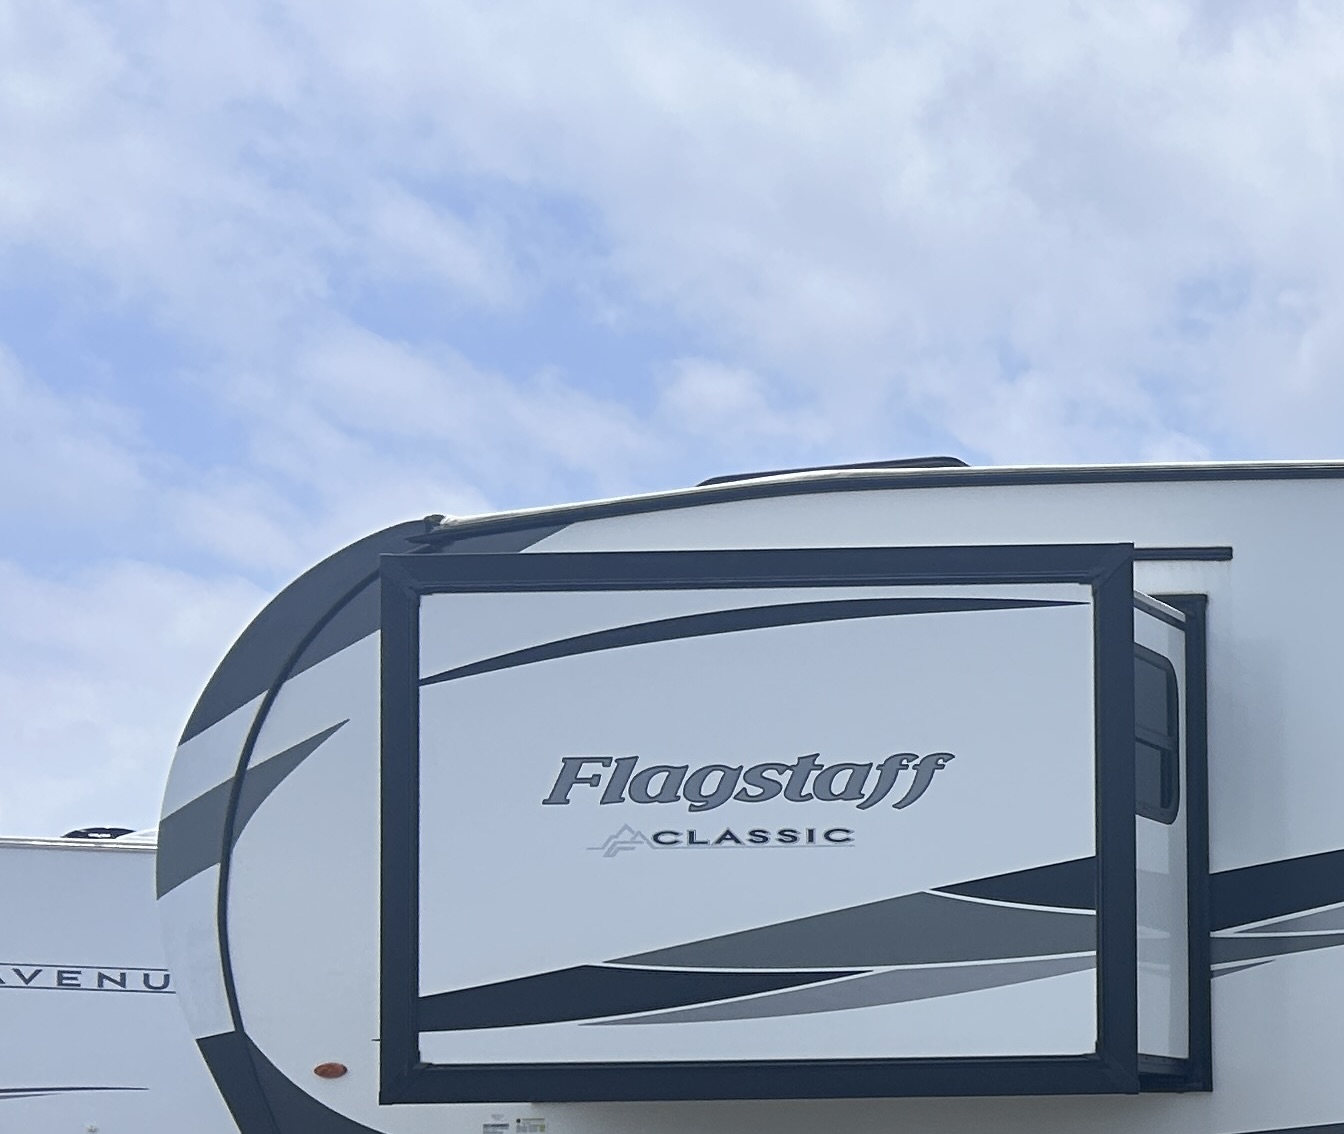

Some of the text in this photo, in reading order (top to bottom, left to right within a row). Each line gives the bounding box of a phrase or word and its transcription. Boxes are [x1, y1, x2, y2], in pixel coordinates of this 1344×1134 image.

[542, 752, 956, 812] Flagstaff
[652, 827, 855, 846] CLASSIC
[0, 967, 171, 991] VENU
